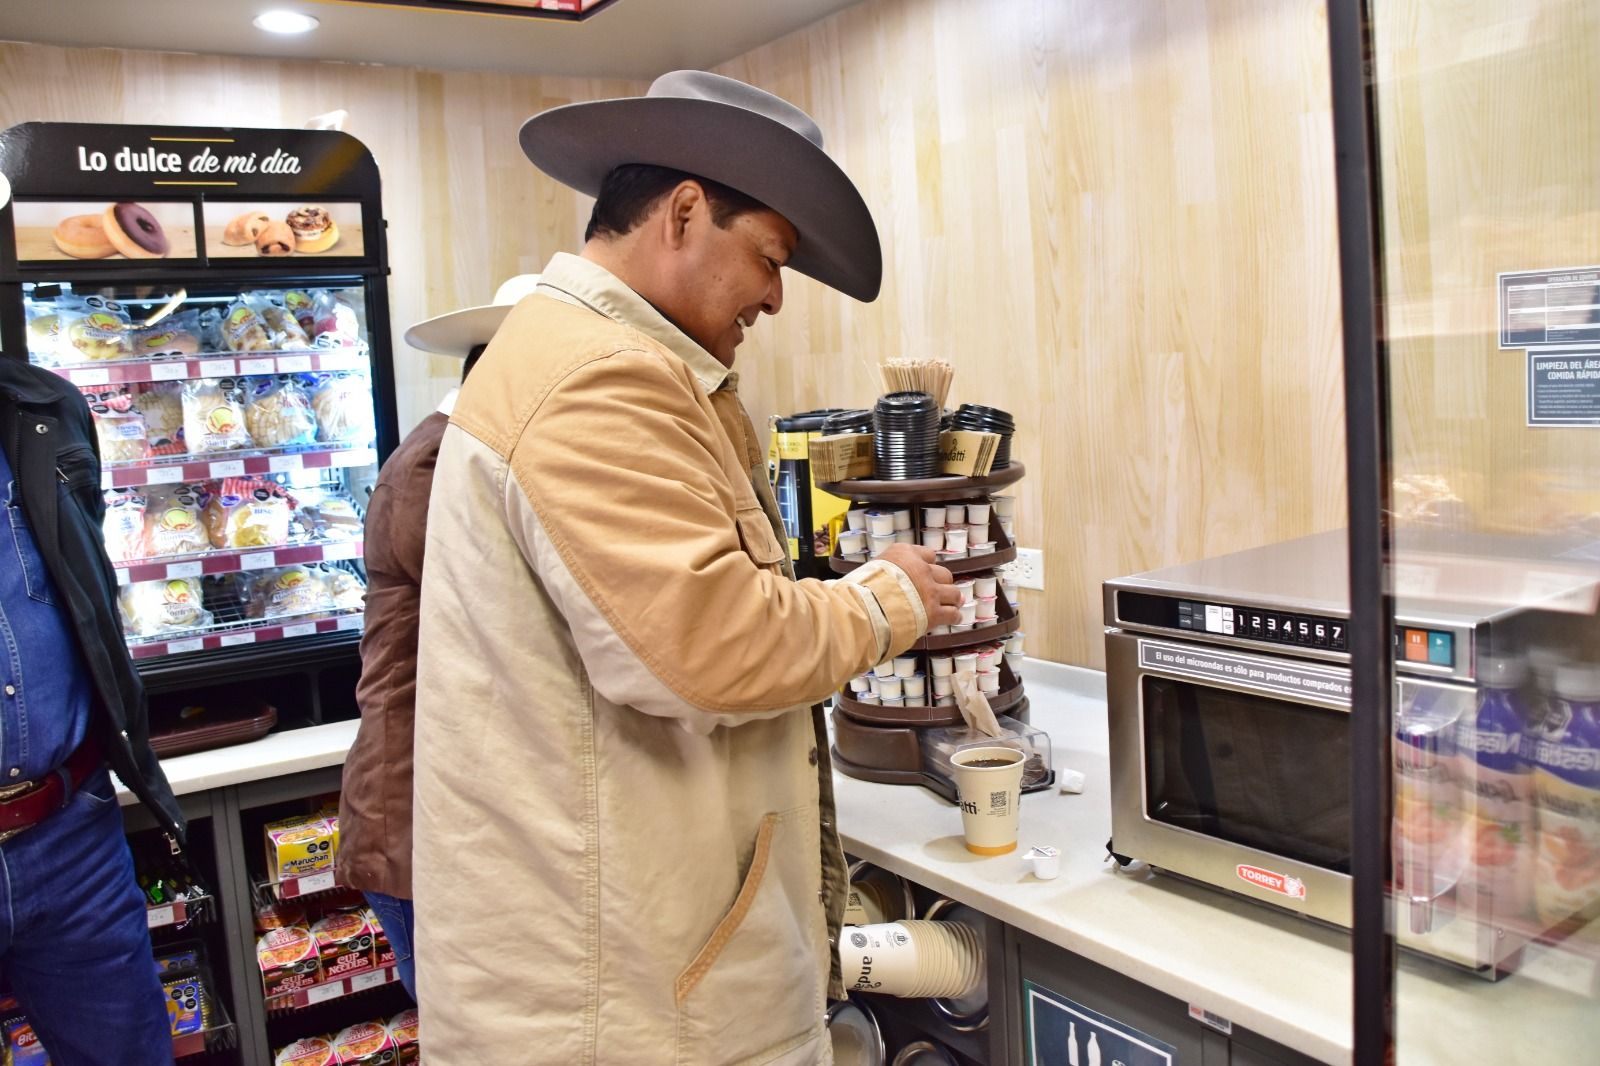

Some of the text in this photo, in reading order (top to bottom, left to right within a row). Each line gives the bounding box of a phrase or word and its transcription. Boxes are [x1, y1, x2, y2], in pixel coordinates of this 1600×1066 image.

[78, 146, 301, 174] Lo dulce de mi día
[1536, 361, 1568, 370] LIMPIEZA
[1569, 361, 1583, 369] DEL
[1547, 371, 1575, 380] COMIDA
[1239, 614, 1244, 626] 1
[1252, 616, 1260, 628] 2
[1267, 618, 1276, 630] 3
[1283, 620, 1292, 632] 4
[1299, 622, 1308, 635] 5
[1315, 624, 1325, 637] 6
[1332, 627, 1341, 639] 7
[1155, 651, 1162, 660] El
[1163, 654, 1174, 662] uso
[1175, 655, 1185, 664] del
[1186, 657, 1224, 672] microondas
[1233, 665, 1248, 675] sólo
[1248, 669, 1265, 678] para
[1265, 672, 1302, 685] productos
[1302, 678, 1342, 692] comprados
[290, 854, 329, 866] Maruchan
[1241, 867, 1282, 888] TORREY
[337, 952, 360, 964] CUP
[328, 957, 369, 976] NOODLES
[281, 973, 305, 986] CUP
